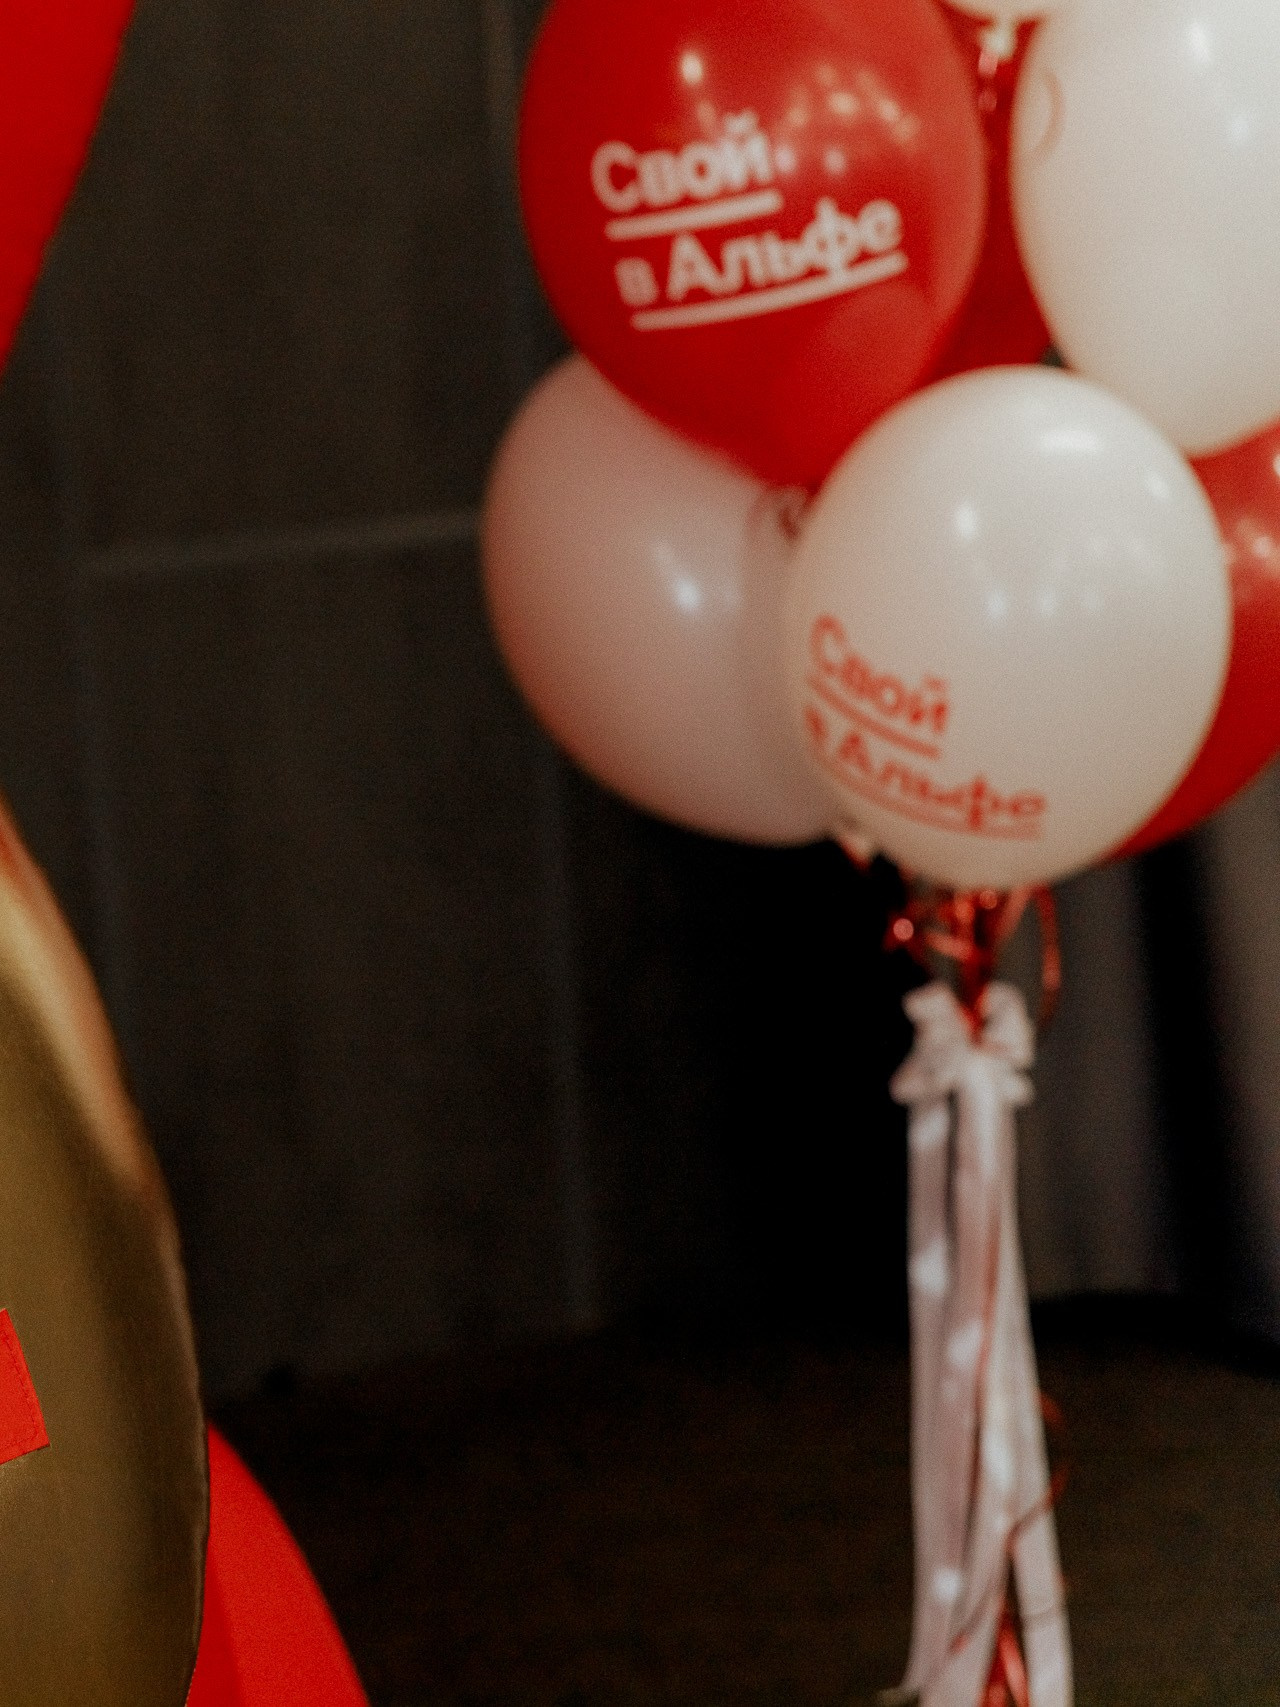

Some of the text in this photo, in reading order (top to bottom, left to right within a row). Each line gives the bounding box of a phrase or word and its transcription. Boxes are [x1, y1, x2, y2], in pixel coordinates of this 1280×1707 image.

[591, 109, 774, 213] Свой
[667, 197, 903, 302] Альфе
[809, 613, 949, 734] Свой
